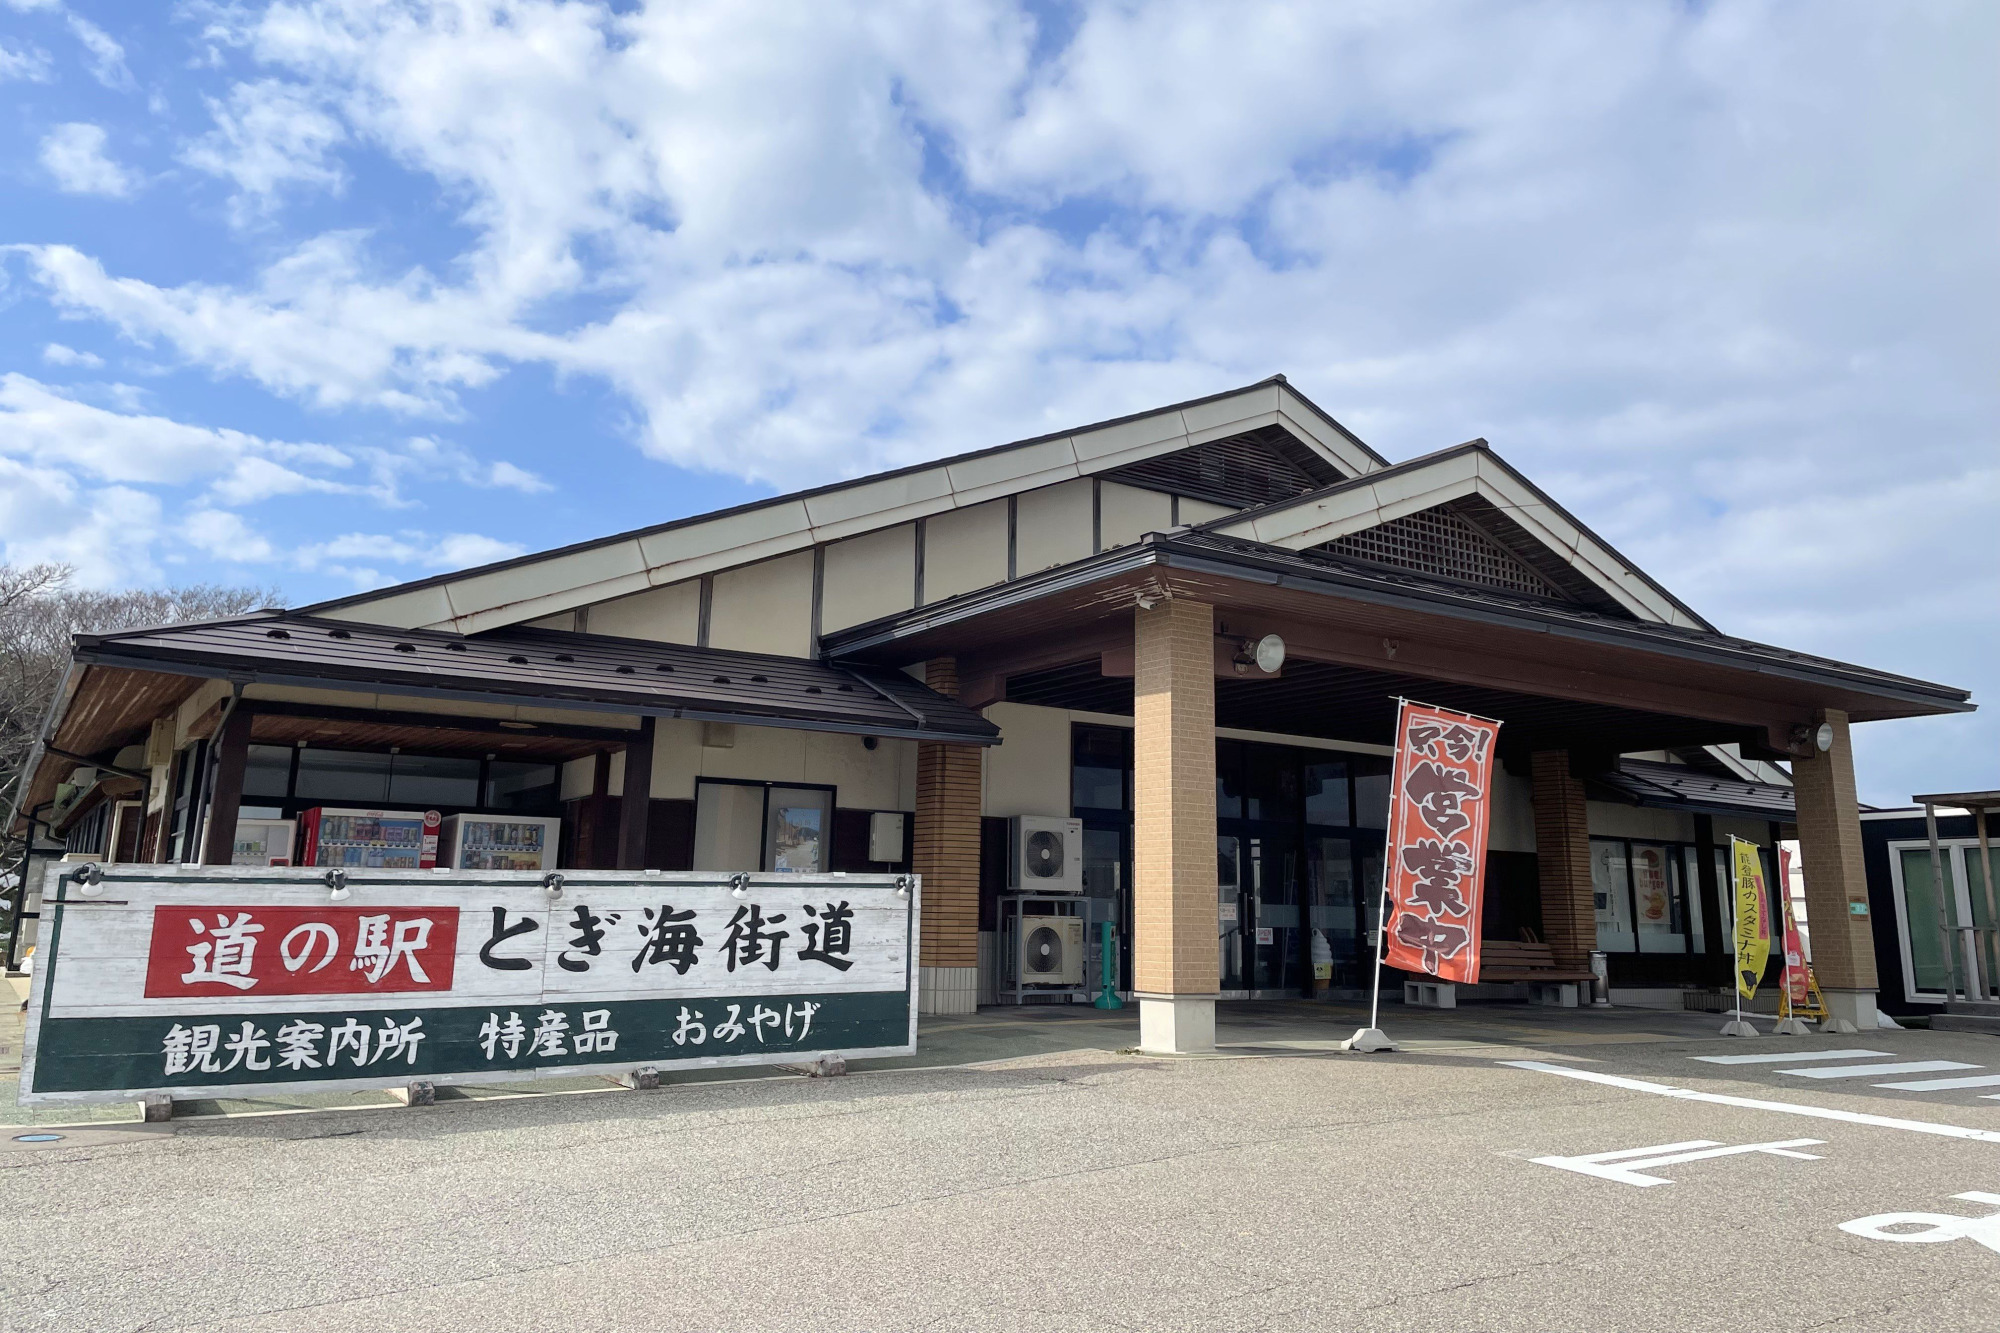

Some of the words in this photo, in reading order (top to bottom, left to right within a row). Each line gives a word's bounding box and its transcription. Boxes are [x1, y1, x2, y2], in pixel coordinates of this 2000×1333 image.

[1397, 760, 1483, 976] 営業中
[1737, 853, 1758, 965] 能登豚のスタミナ丼
[180, 912, 434, 990] 道の駅
[479, 900, 855, 976] とぎ海街道
[160, 1016, 427, 1076] 観光案内所
[478, 1008, 620, 1061] 特産品
[671, 1001, 821, 1047] おみやげ
